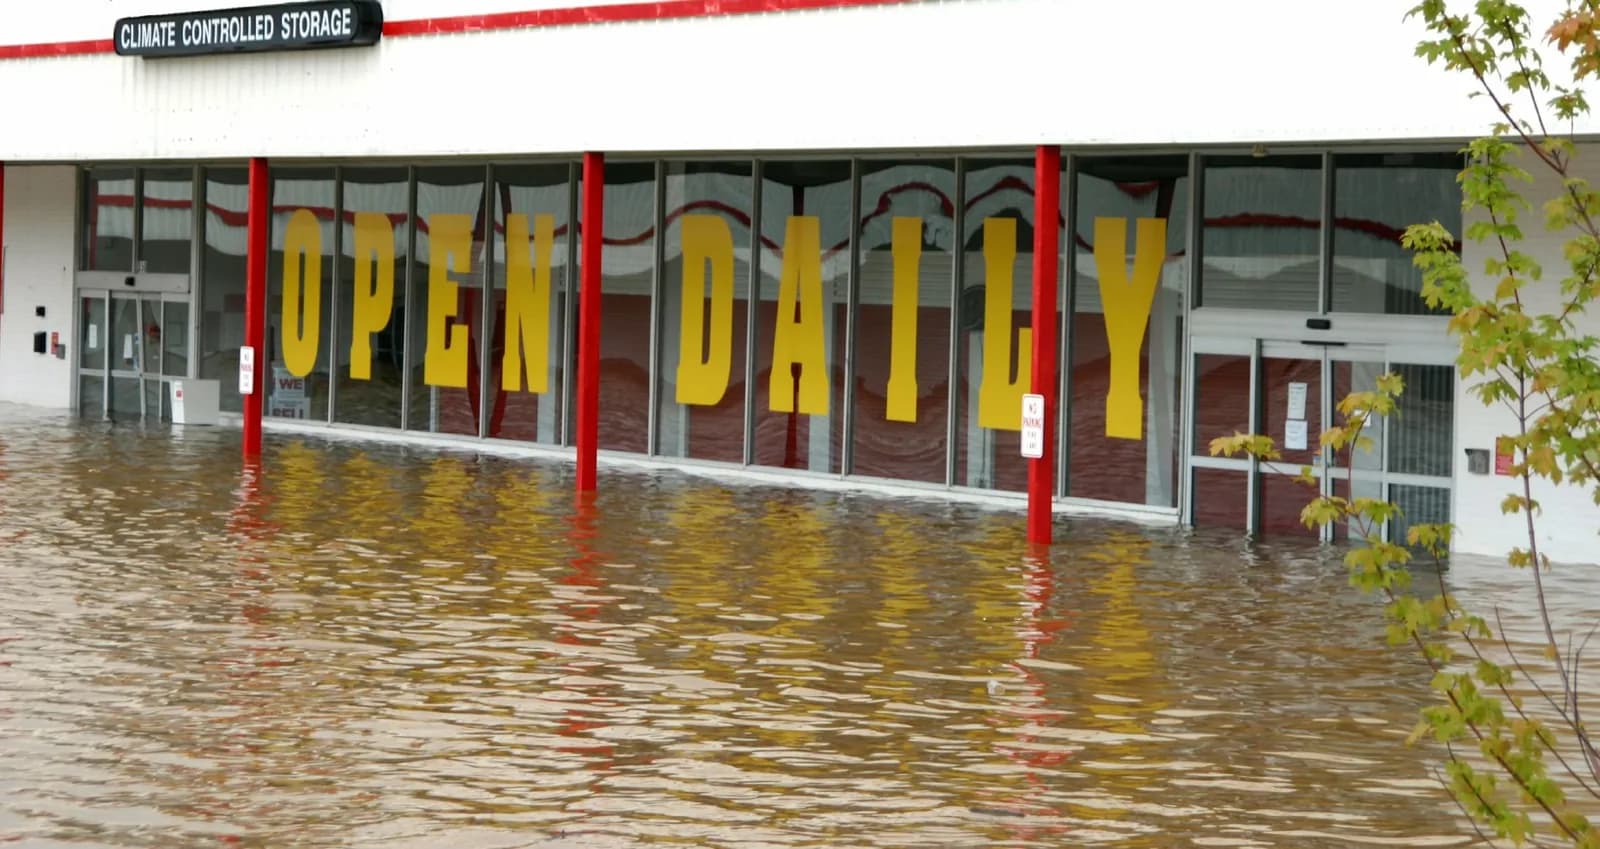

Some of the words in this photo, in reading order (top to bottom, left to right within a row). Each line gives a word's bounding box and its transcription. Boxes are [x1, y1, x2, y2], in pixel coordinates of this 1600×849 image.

[121, 21, 176, 49] CLIMATE
[182, 14, 274, 46] CONTROLLED
[281, 8, 351, 40] STORAGE
[281, 208, 555, 393] OPEN
[676, 214, 1167, 440] DAILY
[279, 377, 303, 390] WE
